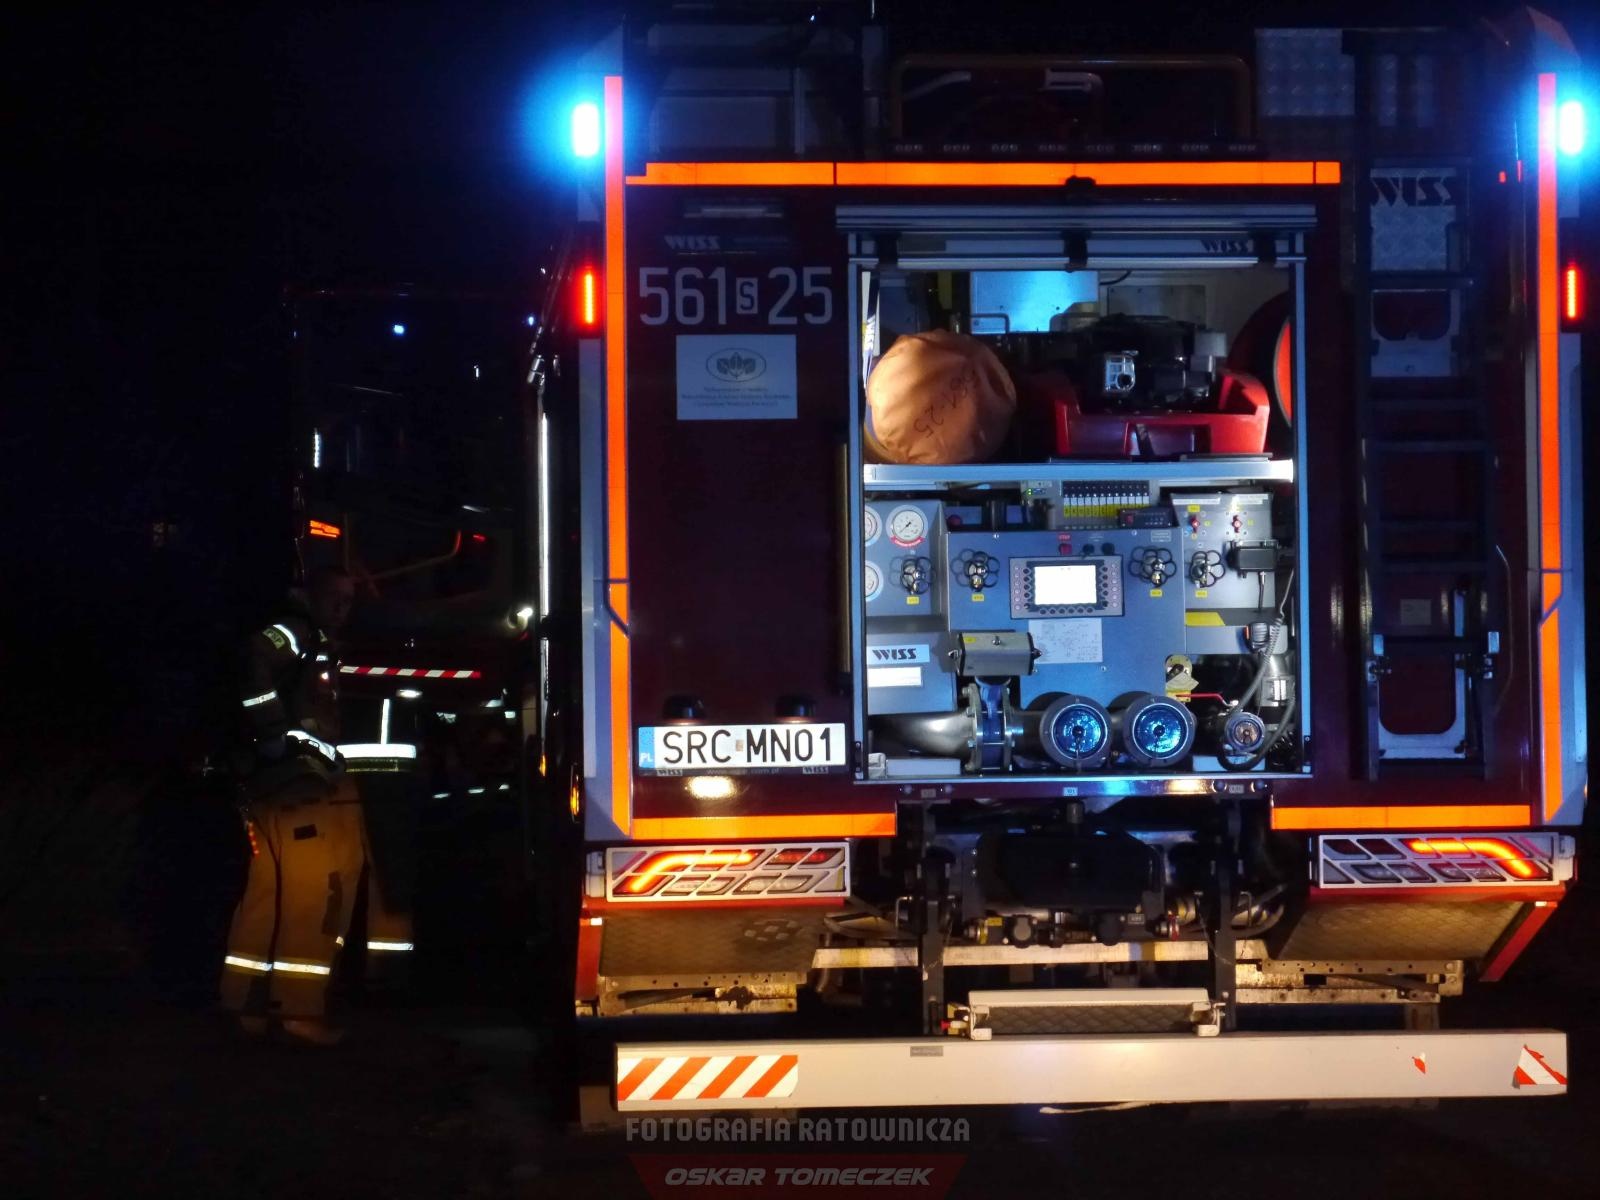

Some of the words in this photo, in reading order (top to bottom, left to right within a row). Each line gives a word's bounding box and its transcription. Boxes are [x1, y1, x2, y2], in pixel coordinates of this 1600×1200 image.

[639, 266, 727, 325] 561
[767, 266, 833, 325] 25
[872, 648, 917, 661] WISS
[640, 754, 654, 764] PL
[662, 730, 732, 765] SRC
